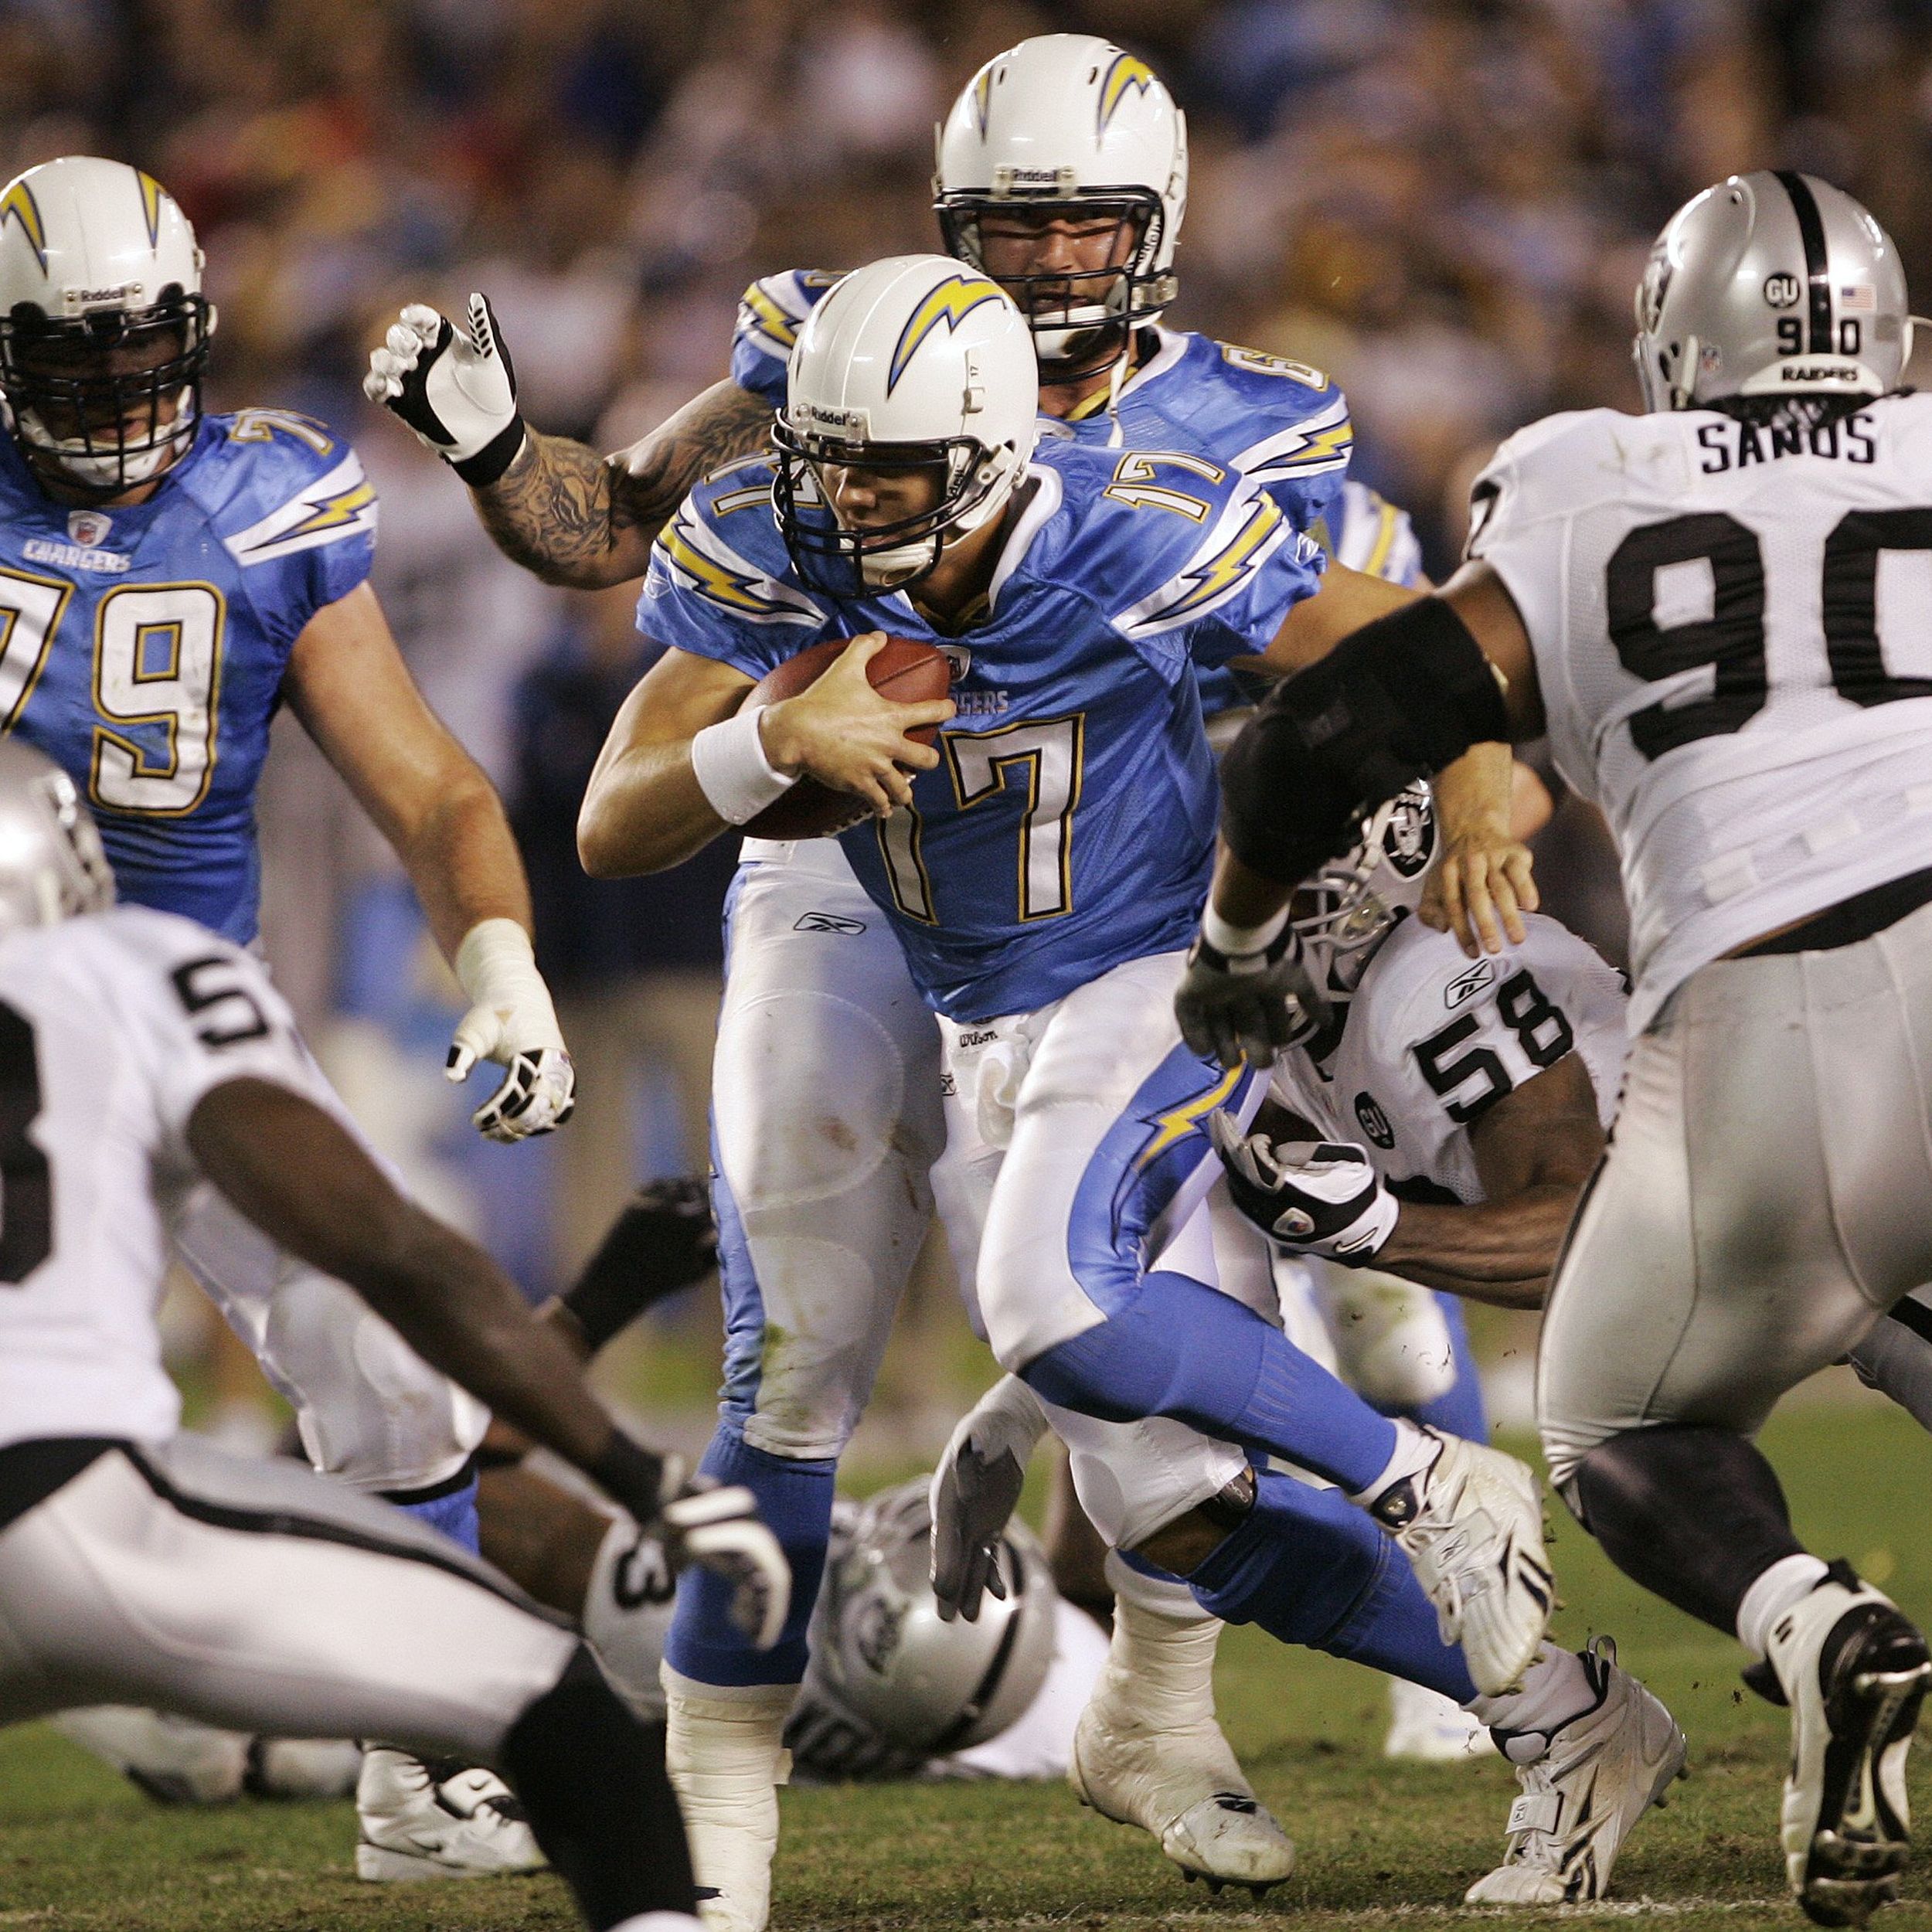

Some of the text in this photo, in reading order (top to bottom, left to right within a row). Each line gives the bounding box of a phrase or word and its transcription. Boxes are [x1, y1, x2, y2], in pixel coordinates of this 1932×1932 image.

[1766, 279, 1798, 303] GU
[969, 365, 979, 377] 17
[1782, 366, 1857, 381] RAIDERS
[1698, 413, 1875, 474] SANDS
[1102, 451, 1227, 525] 17
[22, 539, 132, 573] CHARGERS
[876, 713, 1086, 926] 17
[959, 1030, 998, 1048] Wilson
[1412, 969, 1573, 1124] 58
